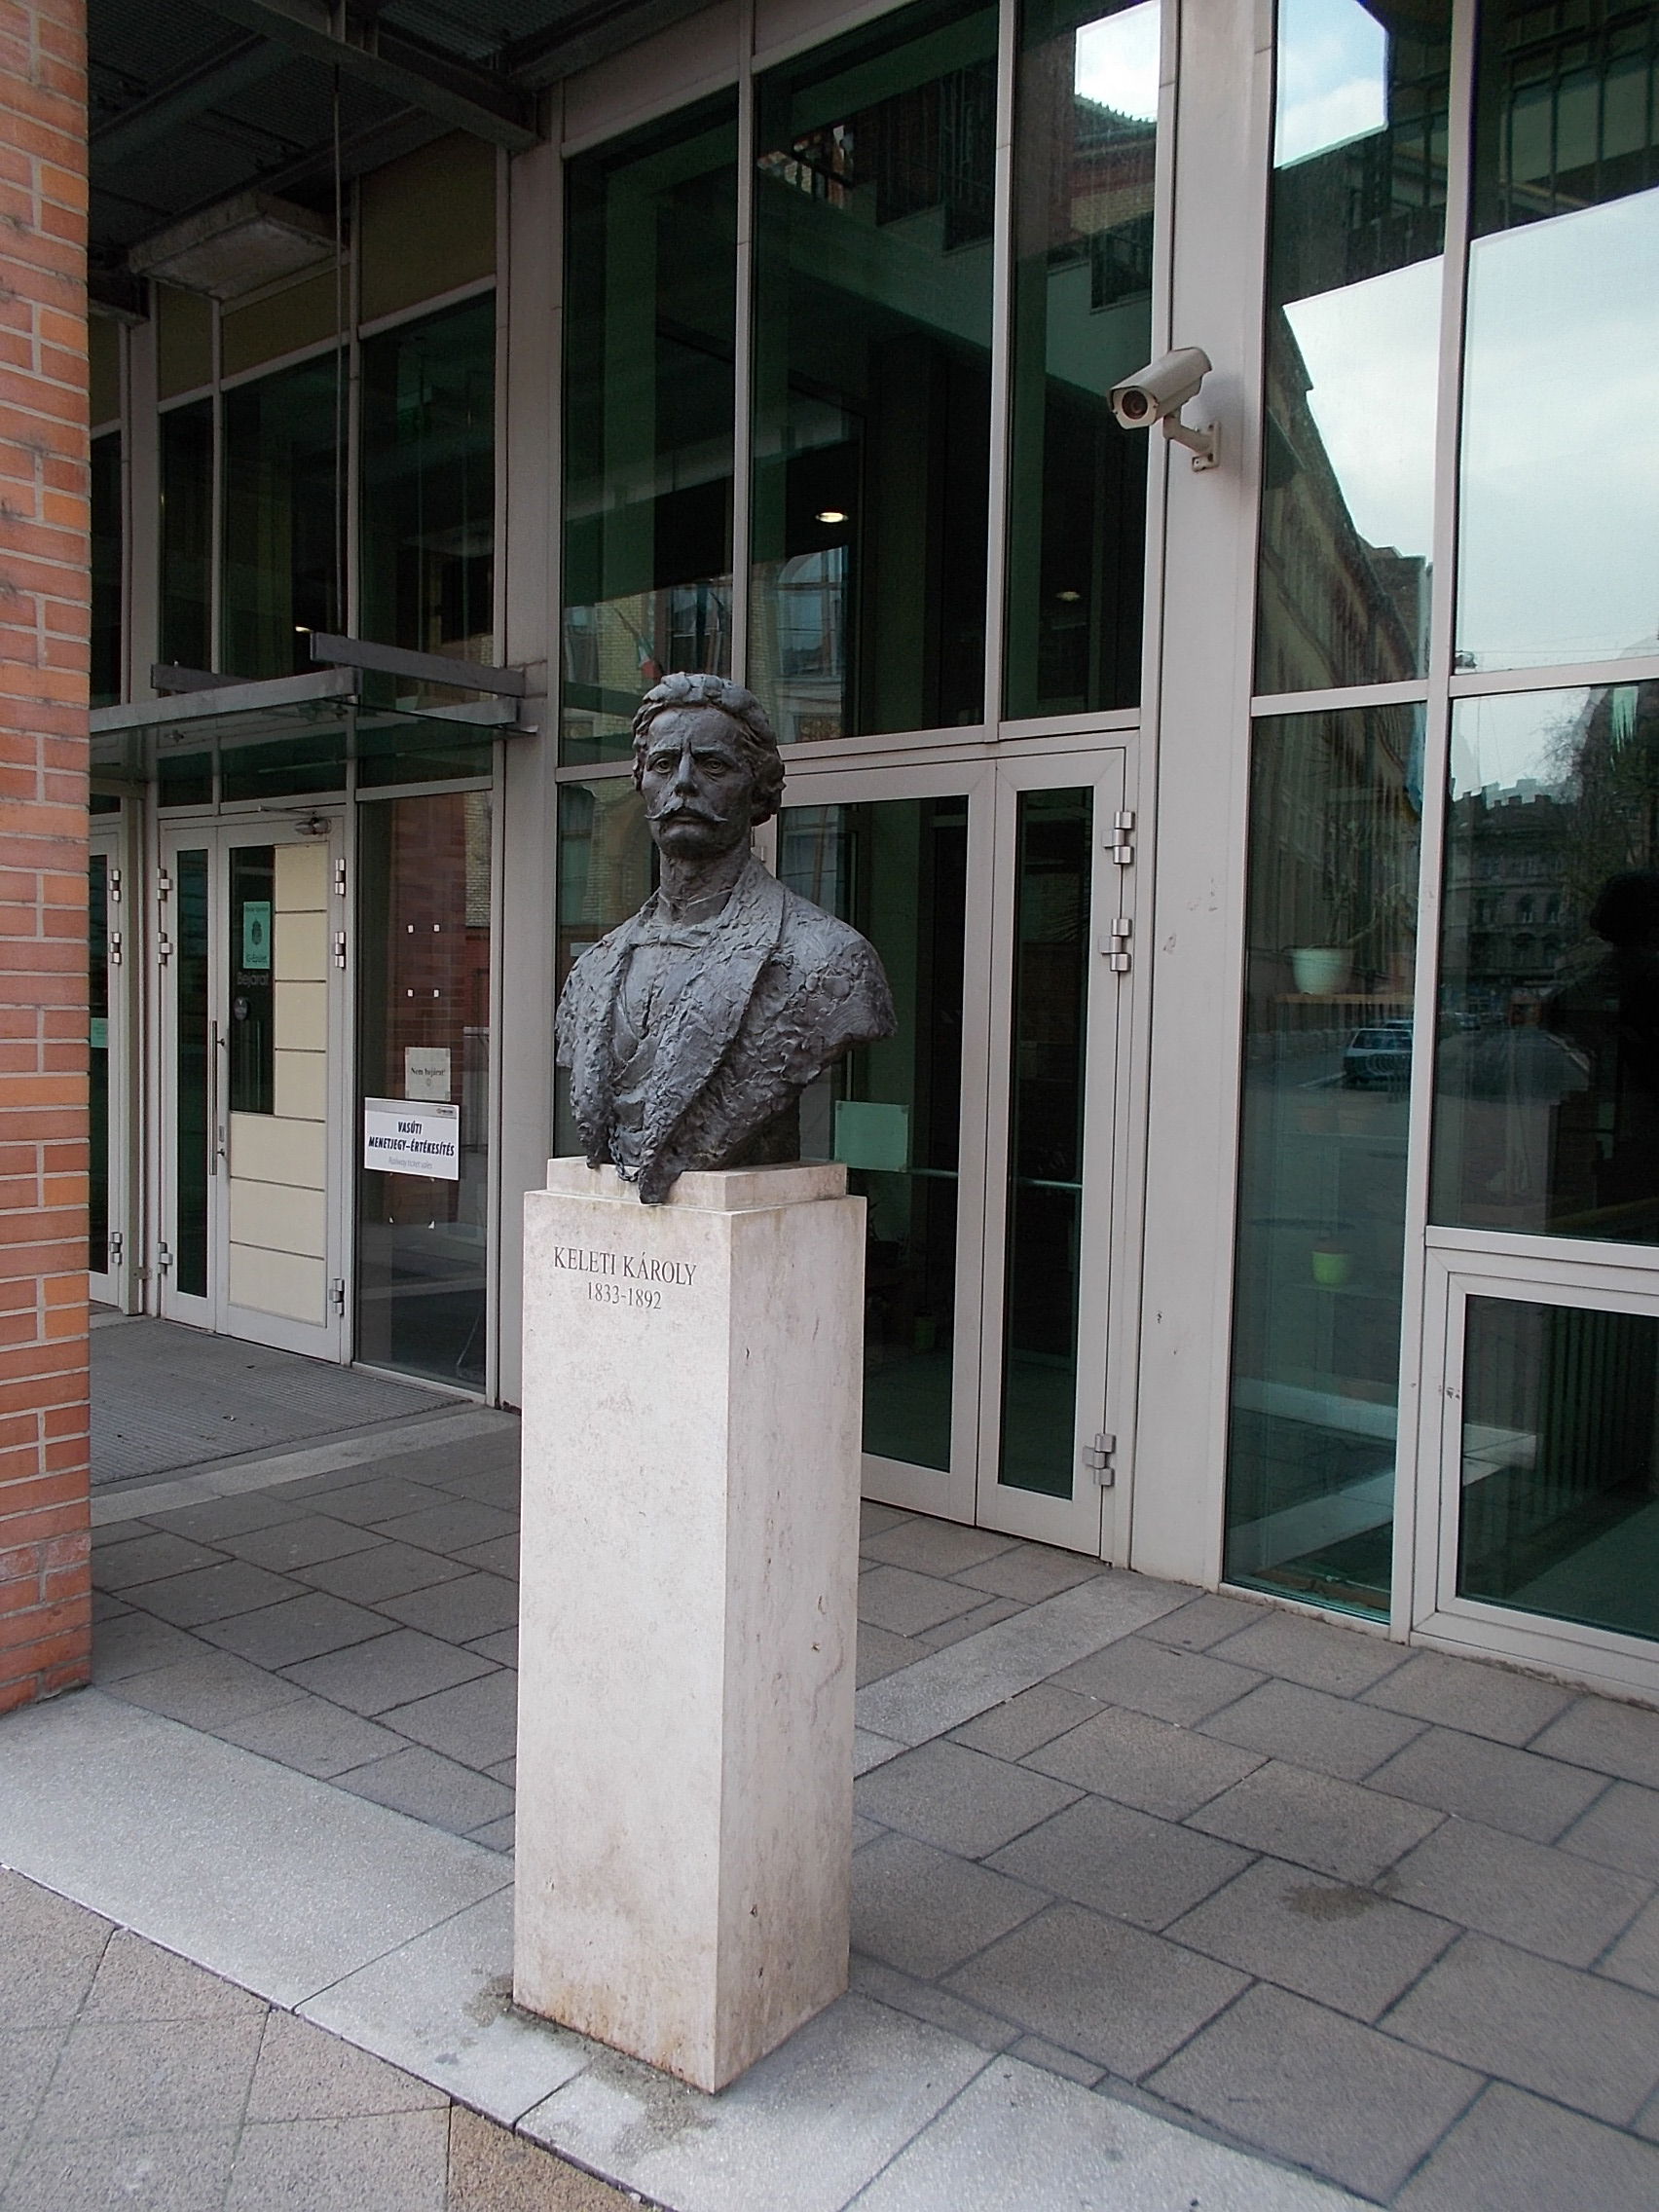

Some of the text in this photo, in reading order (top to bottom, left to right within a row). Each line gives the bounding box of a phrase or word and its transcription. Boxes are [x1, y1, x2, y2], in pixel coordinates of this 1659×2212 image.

[397, 1121, 423, 1135] VASÚTI
[554, 1246, 697, 1286] KELETI KÁROLY
[587, 1281, 662, 1309] 1833-1892
